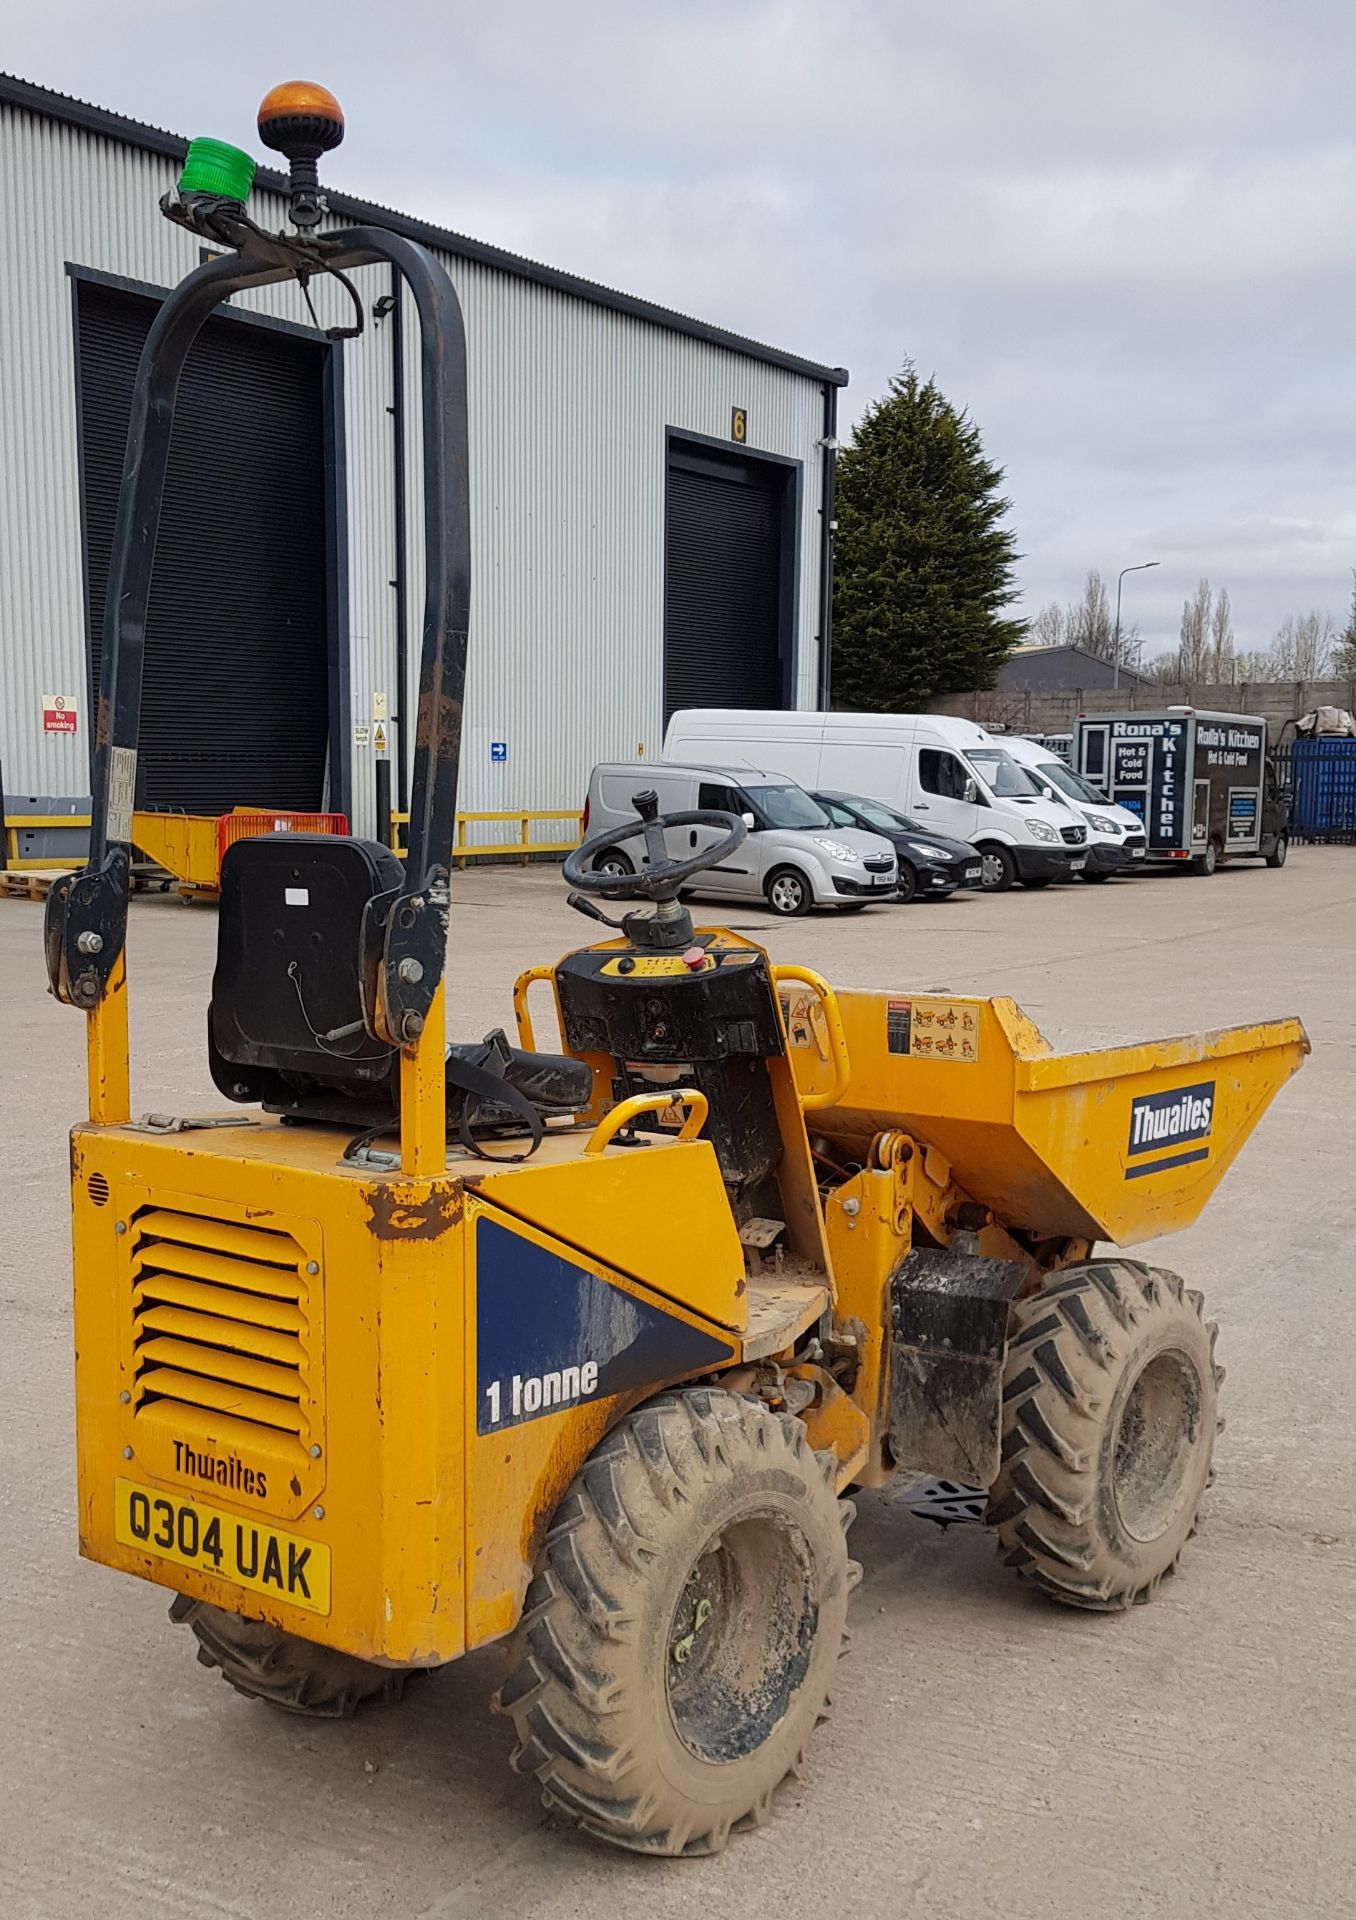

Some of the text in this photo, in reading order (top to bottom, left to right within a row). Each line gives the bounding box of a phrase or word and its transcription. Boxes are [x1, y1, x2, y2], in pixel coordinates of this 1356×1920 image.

[734, 410, 745, 439] 6
[55, 711, 66, 720] No
[46, 720, 75, 731] smoking
[355, 727, 369, 735] SLOW
[1113, 721, 1182, 737] Rona's
[1228, 729, 1260, 749] Kitchen
[1118, 747, 1146, 757] Hot &
[1207, 750, 1218, 766] Hot
[1223, 751, 1235, 766] Cold
[1235, 752, 1248, 767] Food
[1121, 758, 1143, 769] Cold
[1120, 770, 1143, 780] Food
[1160, 737, 1177, 837] Kitchen
[1133, 1094, 1212, 1145] Thwaites
[486, 1360, 598, 1424] 1 tonne
[172, 1439, 267, 1498] Thwaites
[129, 1491, 312, 1600] Q304 UAK
